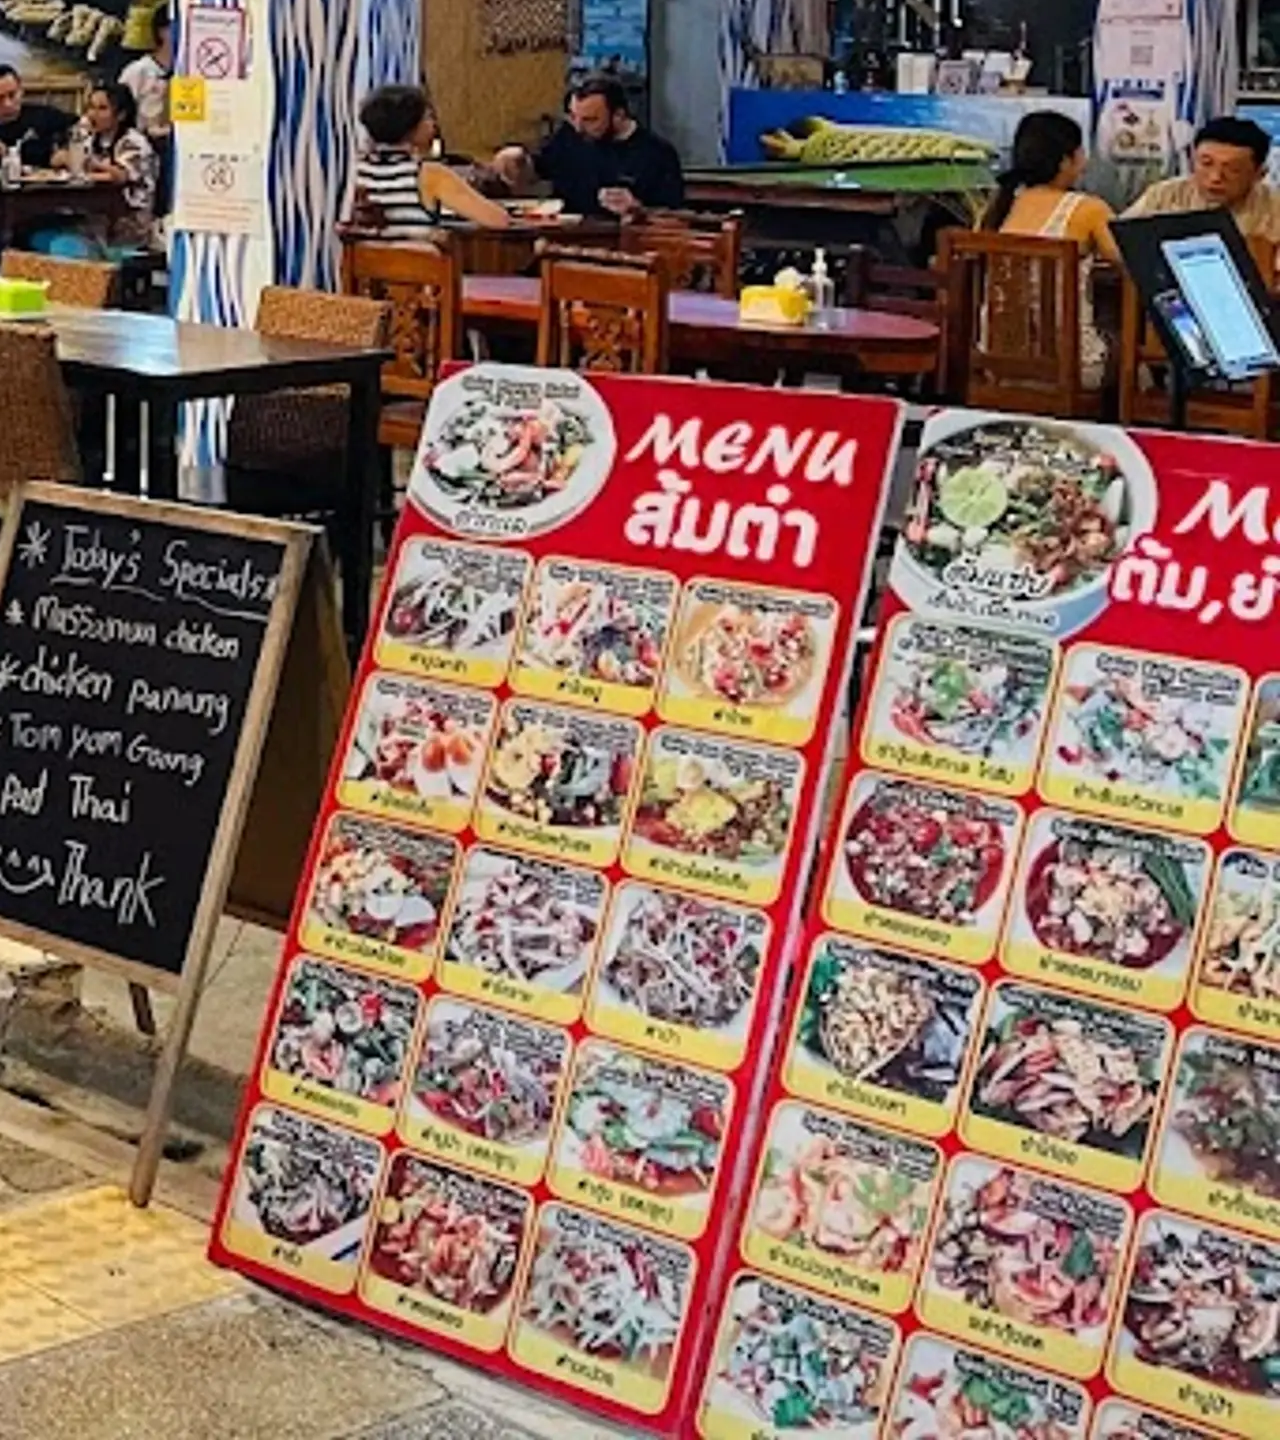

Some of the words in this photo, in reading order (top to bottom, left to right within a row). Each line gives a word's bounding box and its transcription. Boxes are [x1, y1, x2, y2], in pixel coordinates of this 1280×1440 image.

[622, 470, 820, 569] ส้มตำ
[1173, 479, 1280, 545] M
[62, 523, 142, 590] Today's
[9, 712, 63, 752] Tom
[68, 773, 134, 824] Thai
[57, 839, 166, 928] Thank
